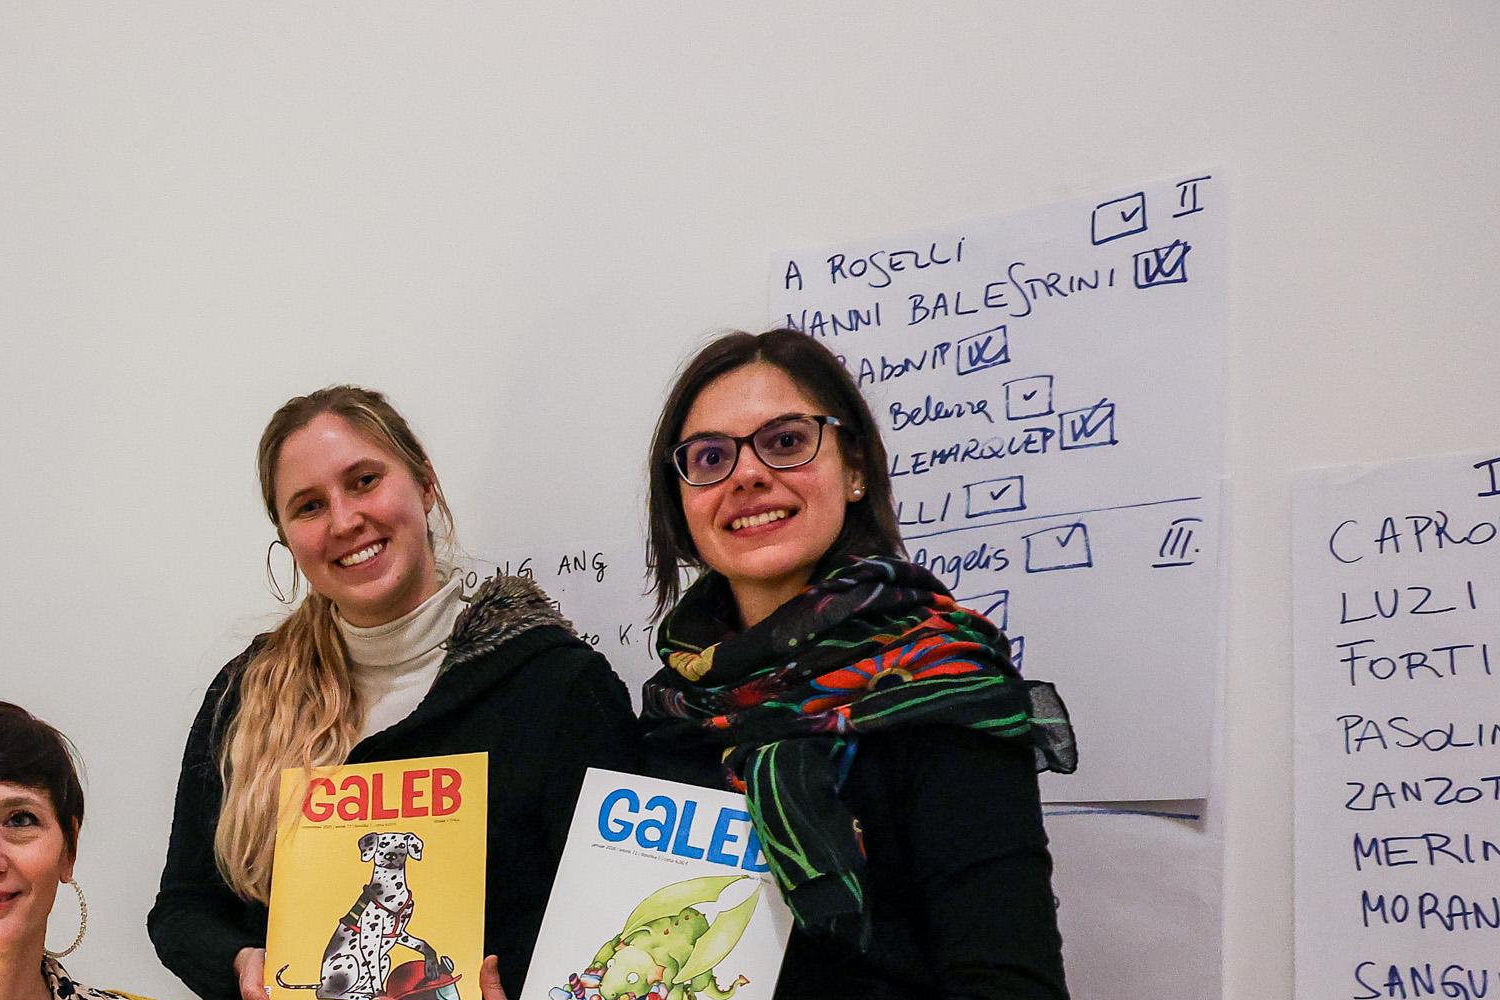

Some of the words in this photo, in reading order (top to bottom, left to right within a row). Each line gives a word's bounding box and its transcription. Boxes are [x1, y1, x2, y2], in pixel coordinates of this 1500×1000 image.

[784, 260, 803, 291] A
[787, 302, 881, 338] NANNI
[908, 262, 1115, 326] BALESTRINI
[557, 549, 609, 582] ANG
[1339, 580, 1477, 624] LUZI
[1336, 638, 1492, 686] FORTI
